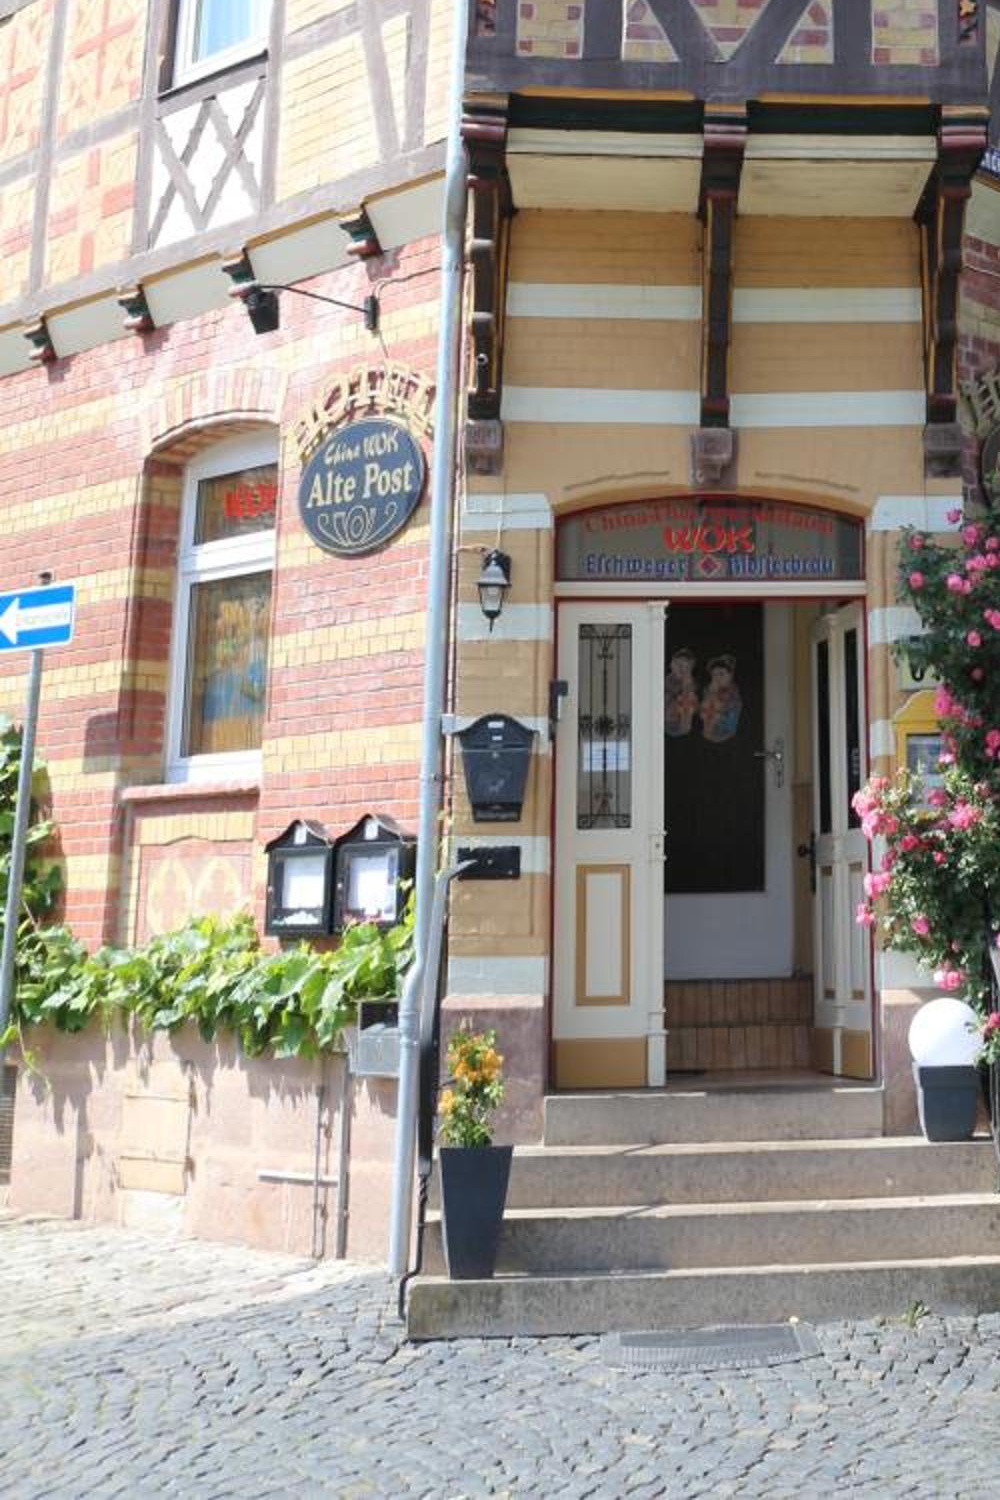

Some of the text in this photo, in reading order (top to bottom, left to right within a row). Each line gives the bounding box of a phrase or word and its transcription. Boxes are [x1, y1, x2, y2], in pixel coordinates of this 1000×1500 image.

[324, 427, 400, 466] China WOK
[306, 459, 414, 509] Alte Post
[662, 524, 756, 554] WOK
